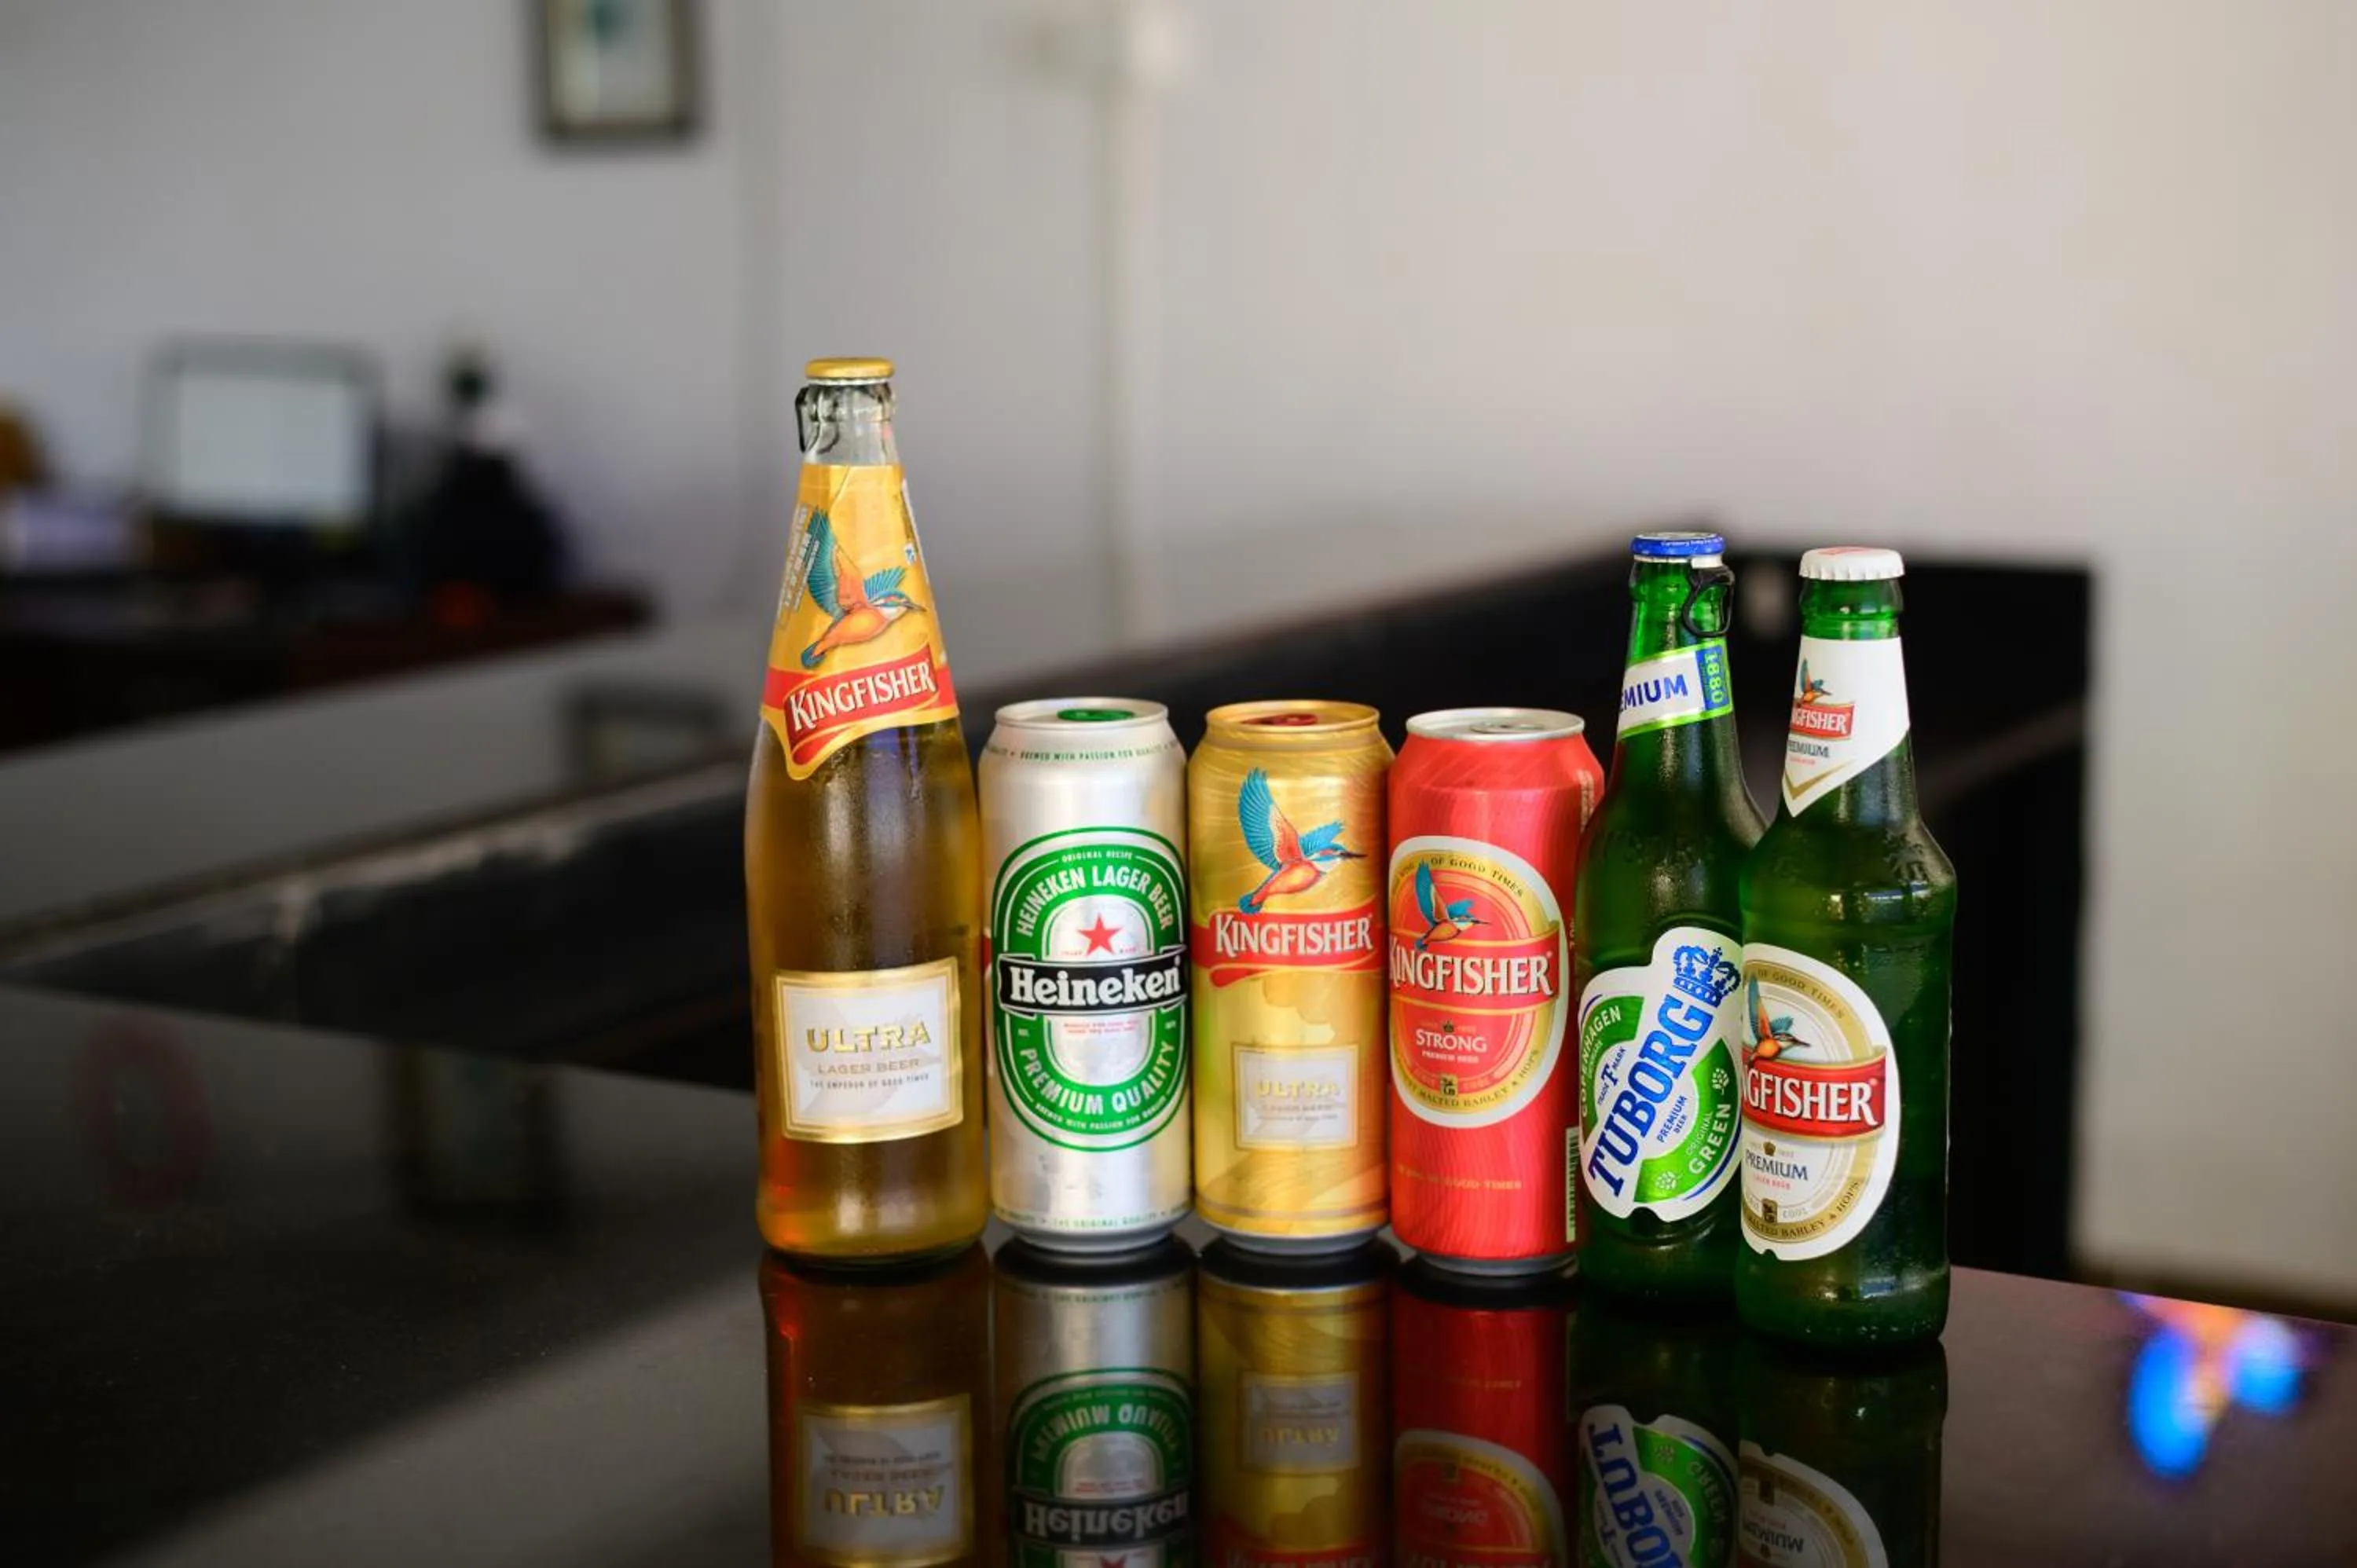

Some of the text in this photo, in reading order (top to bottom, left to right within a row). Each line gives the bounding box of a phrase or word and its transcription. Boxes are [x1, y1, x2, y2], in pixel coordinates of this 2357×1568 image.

[790, 660, 937, 732] KINGFISHER
[1621, 673, 1688, 712] MIUM
[1703, 651, 1725, 704] 1880
[1054, 752, 1076, 761] WITH
[1061, 850, 1103, 863] ORIGINAL
[1450, 858, 1486, 874] GOOD
[1491, 870, 1523, 897] TIMES
[1016, 864, 1175, 938] HEINEKEN LAGER BEER
[1215, 913, 1373, 958] KINGFISHER
[1010, 963, 1181, 1006] Heineken
[1772, 970, 1806, 989] GOOD
[1810, 987, 1845, 1020] TIMES
[806, 1020, 932, 1053] ULTRA
[1416, 1028, 1488, 1053] STRONG
[817, 1057, 921, 1075] LAGER BEER
[1581, 1005, 1622, 1118] COPENHAGEN
[1611, 1045, 1627, 1070] MARK
[827, 1079, 865, 1090] EMPEROR
[906, 1072, 929, 1083] TIMES
[1020, 1041, 1177, 1116] PREMIUM QUALITY
[1256, 1079, 1340, 1101] ULTRA
[1420, 1089, 1459, 1107] MALTED
[1463, 1085, 1508, 1107] BARLEY
[1589, 993, 1714, 1198] TUBORG
[1657, 1094, 1688, 1144] PREMIUM
[1673, 1114, 1688, 1134] BEER
[1685, 1111, 1714, 1156] ORIGINAL
[1688, 1103, 1732, 1174] GREEN
[1745, 1149, 1809, 1181] PREMIUM
[1781, 1218, 1826, 1237] BARLEY
[1835, 1181, 1860, 1213] HOPS
